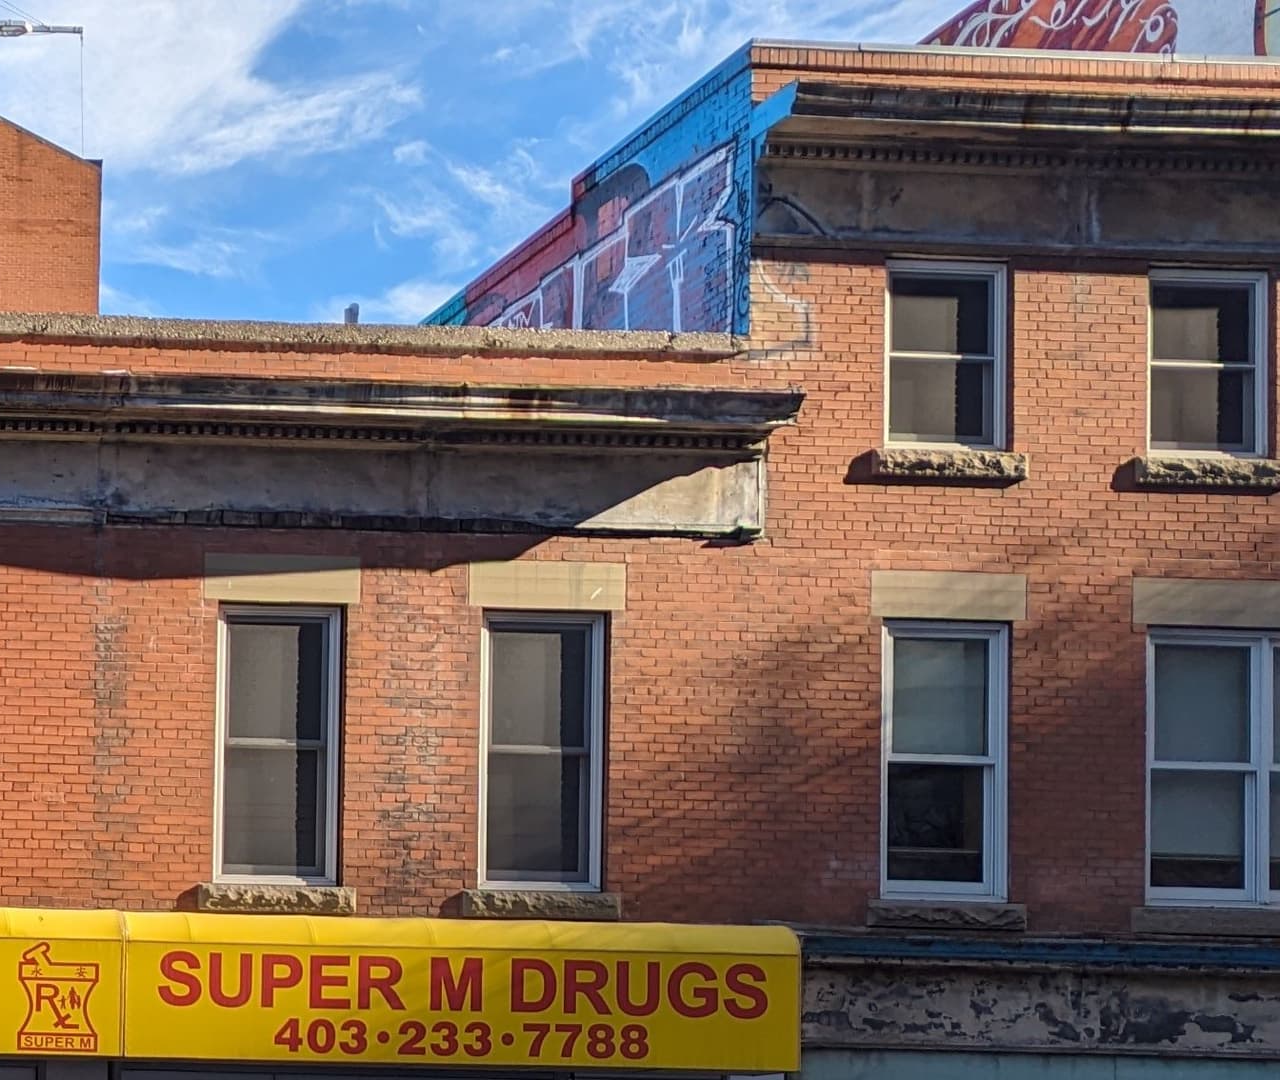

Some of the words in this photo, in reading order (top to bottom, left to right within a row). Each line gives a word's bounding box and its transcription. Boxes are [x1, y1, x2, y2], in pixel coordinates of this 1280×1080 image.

[157, 949, 403, 1012] SUPER
[428, 956, 484, 1013] M
[509, 960, 770, 1020] DRUGS
[23, 1036, 74, 1049] SUPER
[79, 1037, 91, 1049] M
